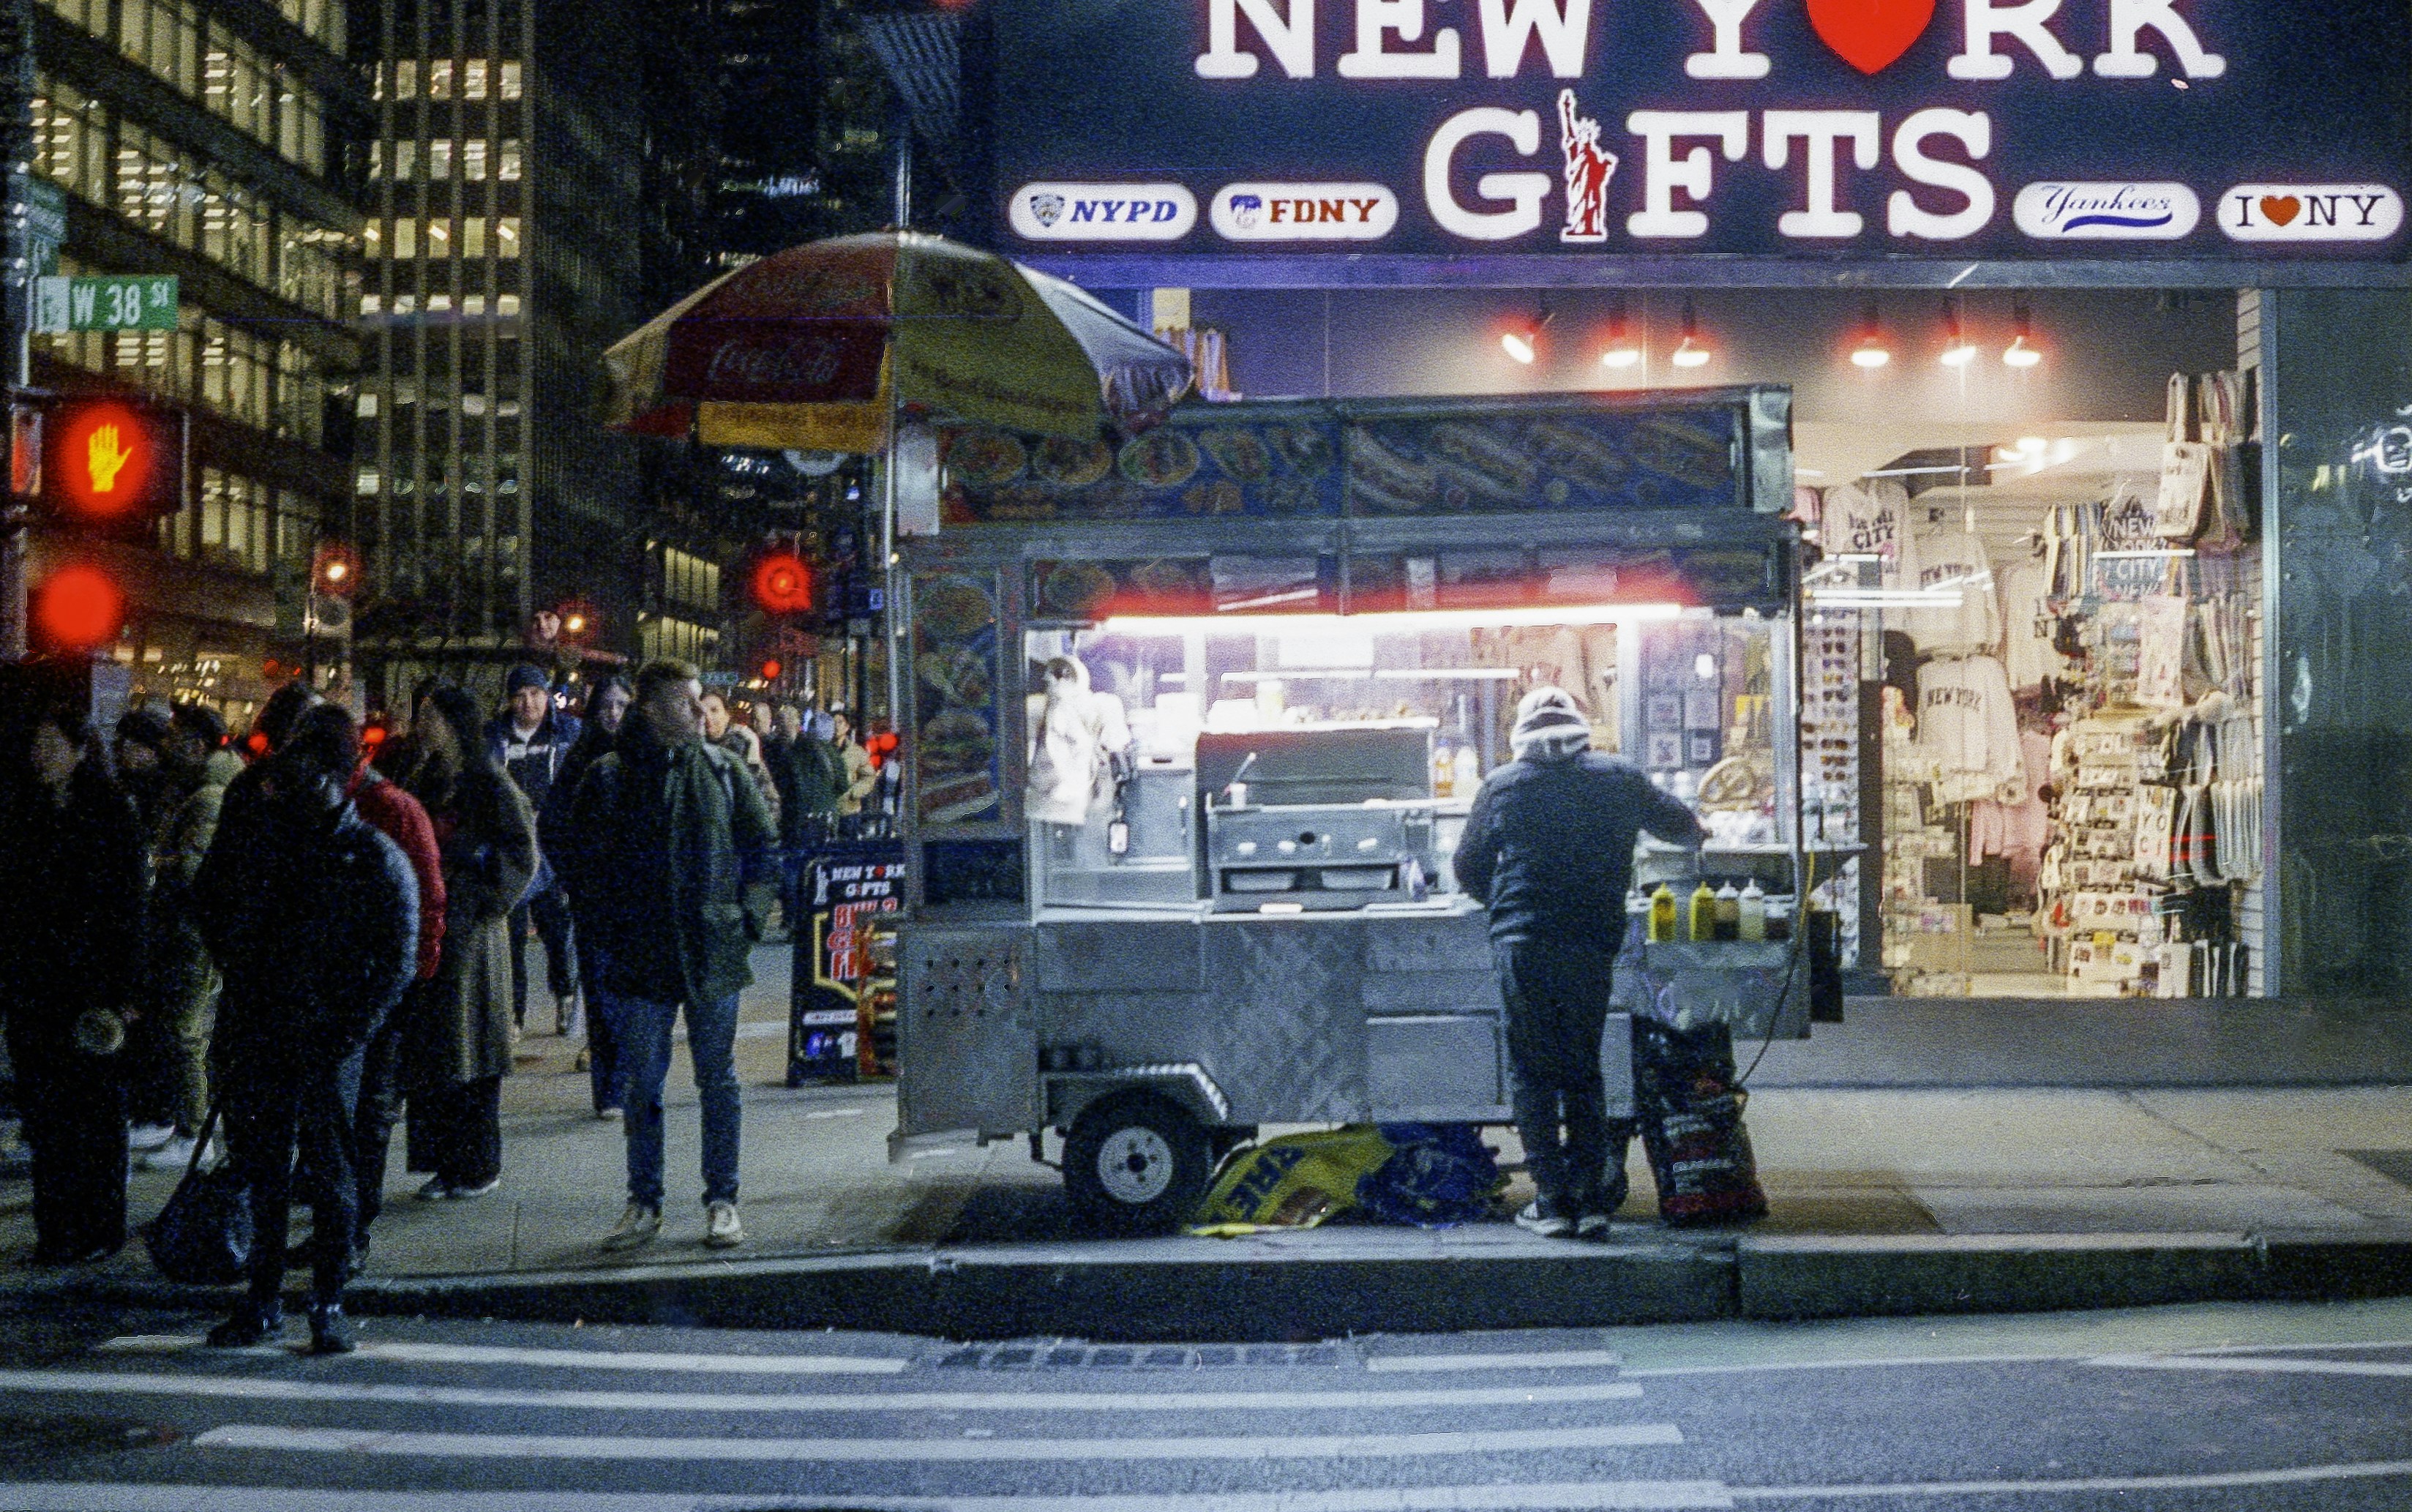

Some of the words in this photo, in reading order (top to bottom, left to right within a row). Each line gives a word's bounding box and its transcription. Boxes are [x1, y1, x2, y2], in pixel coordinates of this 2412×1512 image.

[1194, 0, 1591, 79] NEW
[1069, 199, 1178, 222] NYPD
[1268, 198, 1380, 222] FDNY
[2041, 184, 2173, 225] Yankees
[2234, 195, 2255, 227] I
[2303, 194, 2386, 227] NY
[74, 283, 97, 326] W
[106, 282, 141, 326] 38
[2108, 514, 2154, 541] NEW
[1926, 686, 1954, 708] NEW
